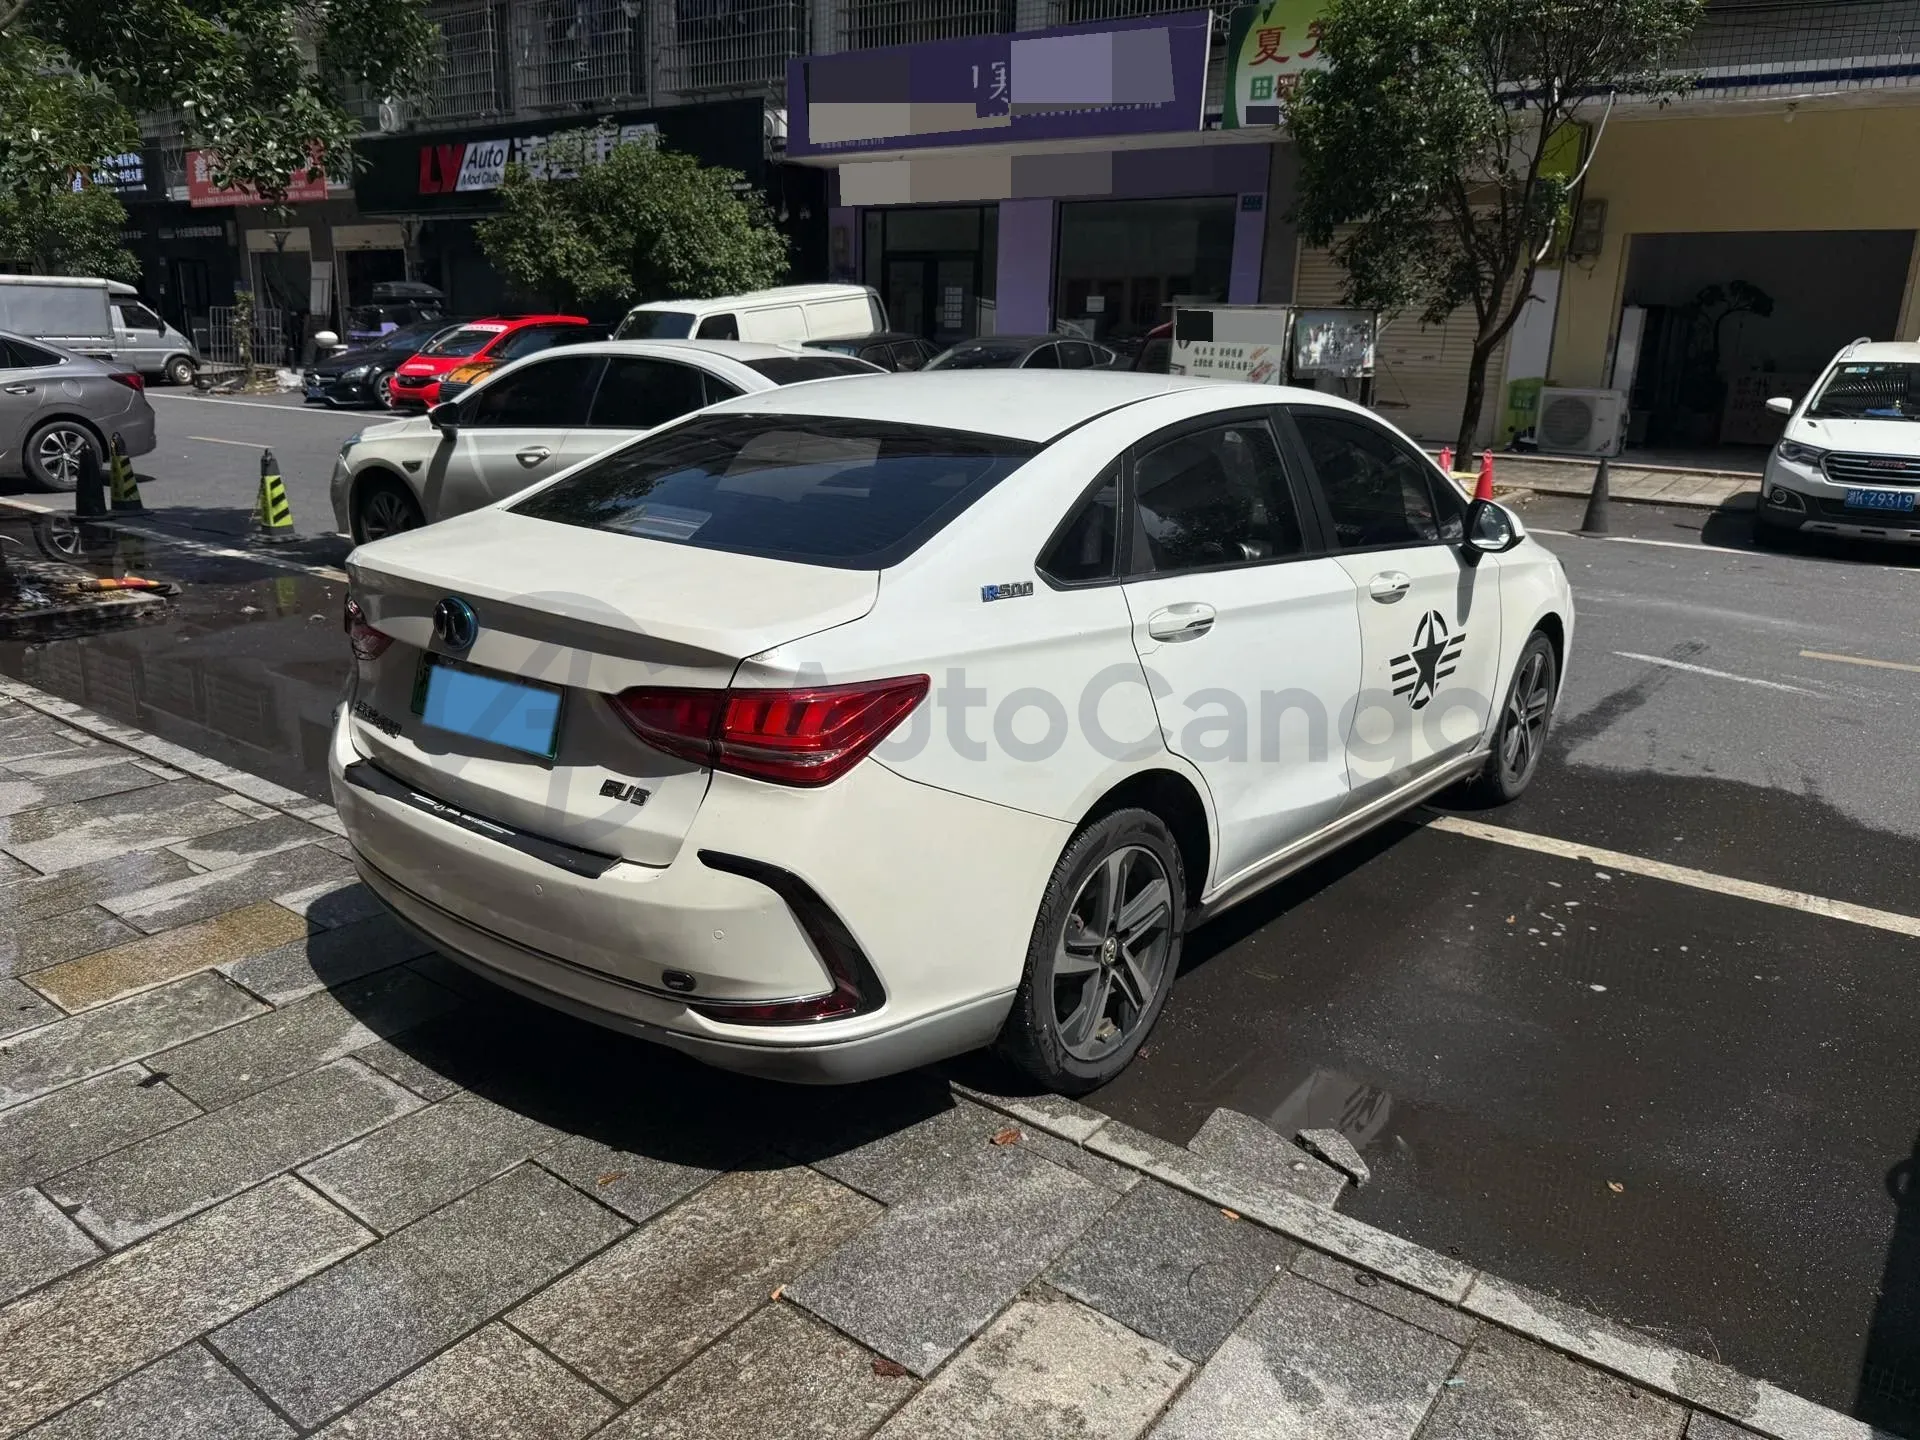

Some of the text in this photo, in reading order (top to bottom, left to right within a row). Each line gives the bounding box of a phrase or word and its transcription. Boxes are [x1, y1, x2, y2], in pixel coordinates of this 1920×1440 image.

[420, 143, 466, 193] LY
[466, 145, 504, 170] Auto
[461, 172, 481, 186] Mod
[981, 581, 1034, 602] R500
